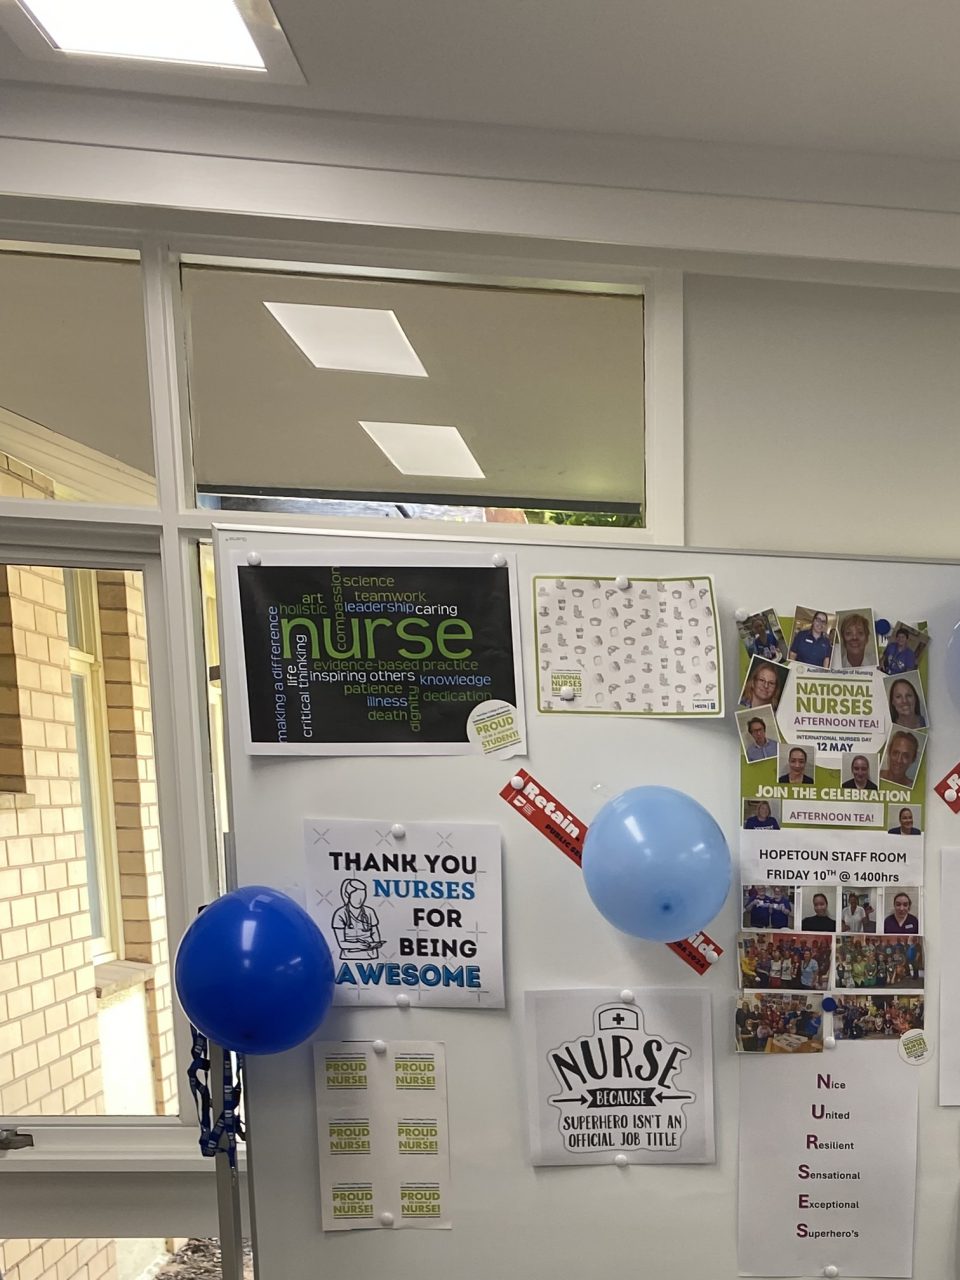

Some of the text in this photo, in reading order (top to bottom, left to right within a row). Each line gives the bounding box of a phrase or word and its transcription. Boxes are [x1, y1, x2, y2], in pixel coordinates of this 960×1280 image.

[342, 576, 395, 587] science
[302, 592, 324, 604] art
[354, 591, 426, 602] teamwork
[280, 603, 328, 615] holistic
[331, 566, 347, 650] compassion
[344, 602, 415, 614] leadership
[415, 604, 458, 616] caring
[280, 617, 474, 660] nurse
[313, 660, 479, 672] evidence-based practice
[268, 606, 287, 743] making a difference
[286, 665, 298, 686] life
[309, 671, 416, 683] inspiring others
[420, 675, 492, 688] knowledge
[296, 634, 313, 738] critical thinking
[344, 683, 403, 696] patience
[796, 682, 873, 697] NATIONAL
[367, 696, 408, 707] illness
[423, 690, 493, 702] dedication
[409, 685, 421, 732] dignity
[796, 697, 873, 715] NURSES
[368, 709, 408, 721] death
[794, 717, 879, 728] AFTERNOON TEA!
[475, 716, 514, 736] PROUD
[817, 742, 853, 752] 12 MAY
[755, 784, 911, 801] JOIN THE CELEBRATION
[789, 811, 874, 822] AFTERNOON TEA!
[329, 851, 477, 875] THANK YOU
[759, 849, 907, 863] HOPETOUN STAFF ROOM
[766, 869, 899, 882] FRIDAY 10TH @ 1400hrs
[372, 879, 475, 900] NURSES
[413, 908, 463, 928] FOR
[399, 938, 477, 958] BEING
[334, 962, 481, 988] AWESOME
[325, 1062, 367, 1072] PROUD
[552, 1034, 688, 1091] NURSE
[326, 1075, 367, 1085] NURSE!
[817, 1073, 846, 1089] Nice
[596, 1090, 647, 1105] BECAUSE
[811, 1104, 850, 1120] United
[563, 1114, 682, 1131] SUPERHERO ISN'T AN
[568, 1132, 677, 1147] OFFICIAL JOB TITLE
[806, 1134, 854, 1150] Resilient
[798, 1164, 860, 1180] Sensational
[400, 1192, 440, 1201] PROUD
[798, 1194, 859, 1210] Exceptional
[401, 1204, 441, 1213] NURSE!
[796, 1223, 859, 1239] Superhero's
